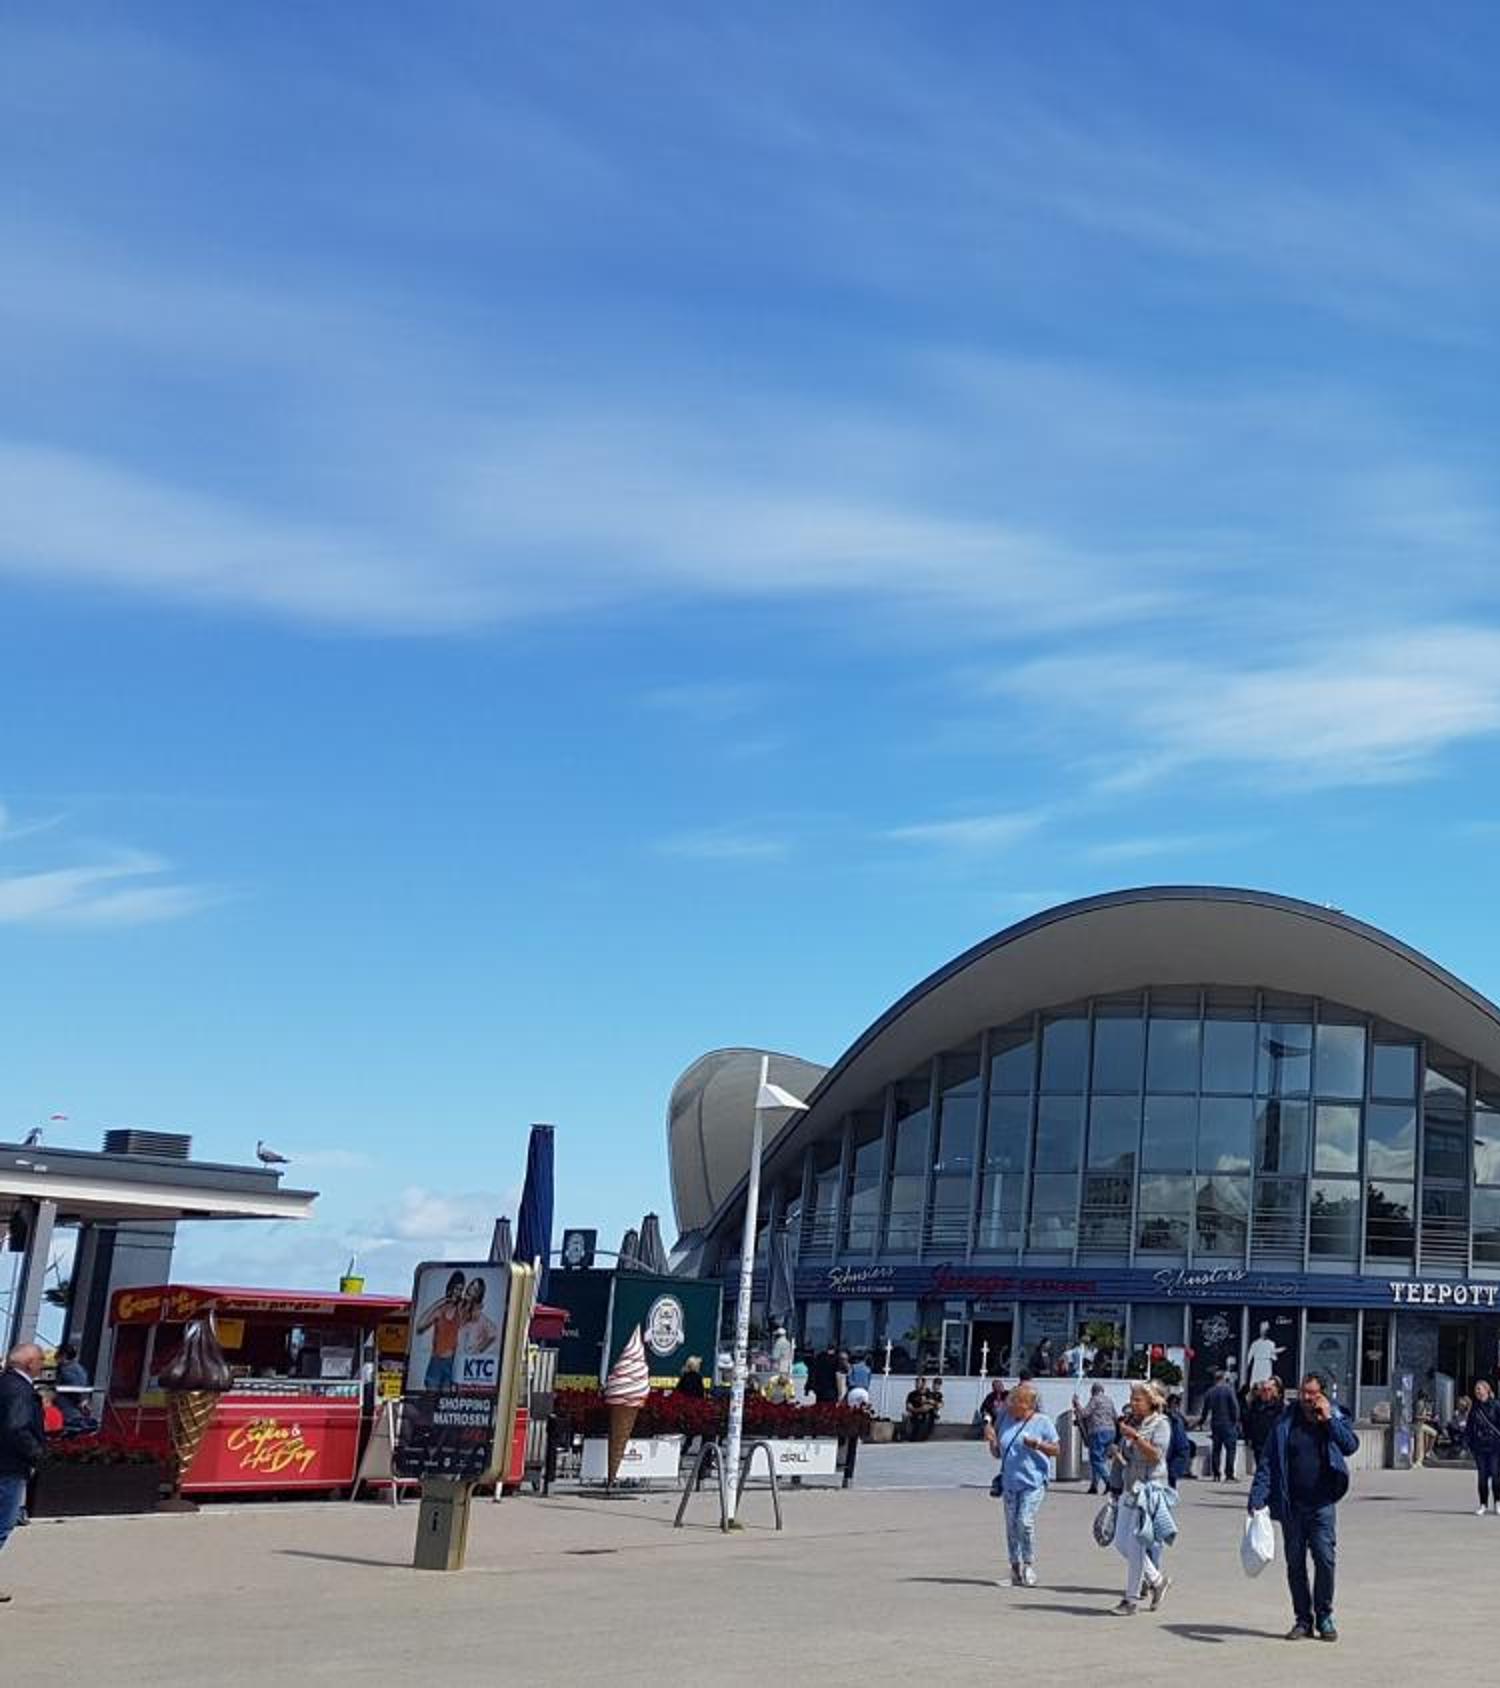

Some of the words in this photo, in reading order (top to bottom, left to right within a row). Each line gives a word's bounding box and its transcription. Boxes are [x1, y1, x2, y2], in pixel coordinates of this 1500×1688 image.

[1389, 1282, 1499, 1306] TEEPOTT
[463, 1359, 495, 1377] KTC
[438, 1397, 491, 1411] SHOPPING
[433, 1411, 490, 1425] MATROSEN
